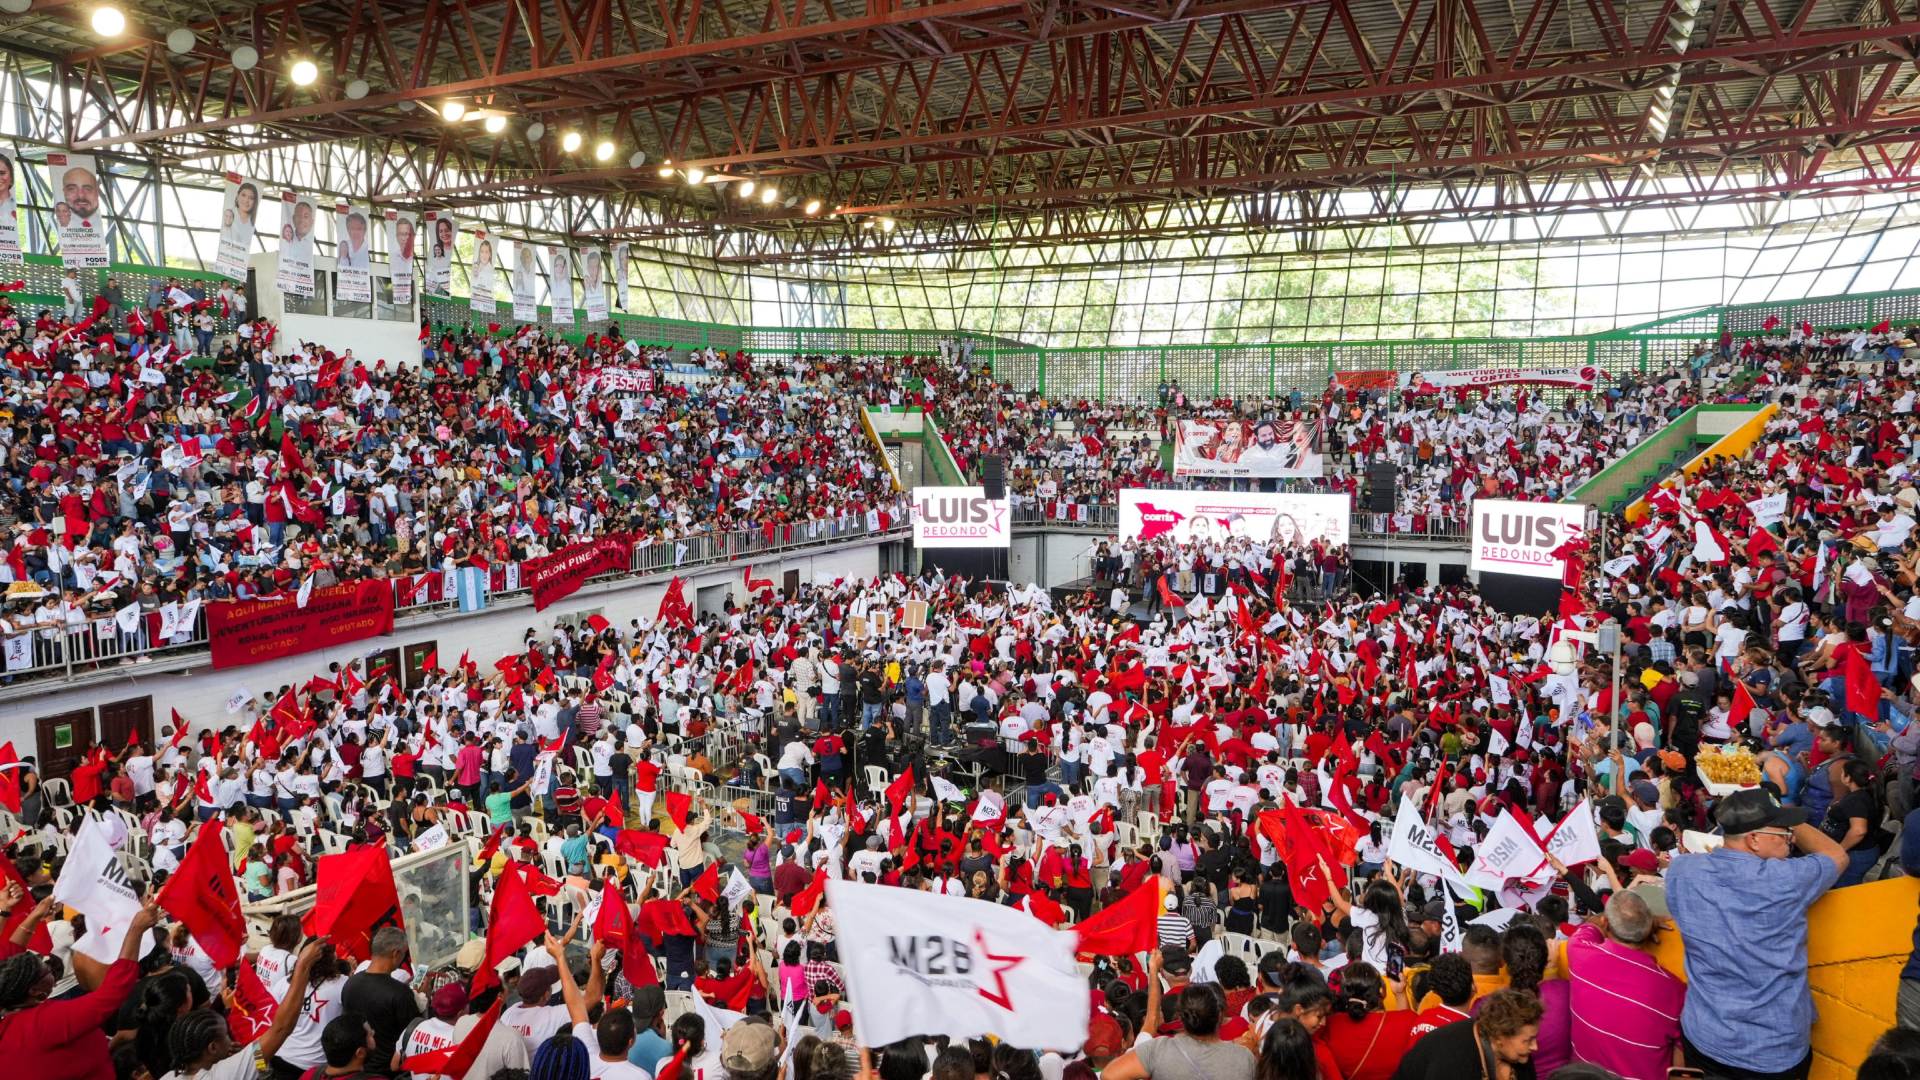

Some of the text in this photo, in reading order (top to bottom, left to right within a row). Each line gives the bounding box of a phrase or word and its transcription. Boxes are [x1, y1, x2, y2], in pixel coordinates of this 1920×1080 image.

[922, 498, 988, 523] LUIS
[1143, 513, 1175, 522] CORTÉS
[923, 526, 987, 536] REDONDO
[1482, 513, 1556, 548] LUIS
[1482, 546, 1554, 563] REDONDO
[226, 592, 296, 620] AQUI MANDA
[330, 618, 375, 635] DIPUTADO
[250, 637, 299, 655] DIPUTADO
[777, 802, 788, 812] 10
[888, 936, 973, 975] M28
